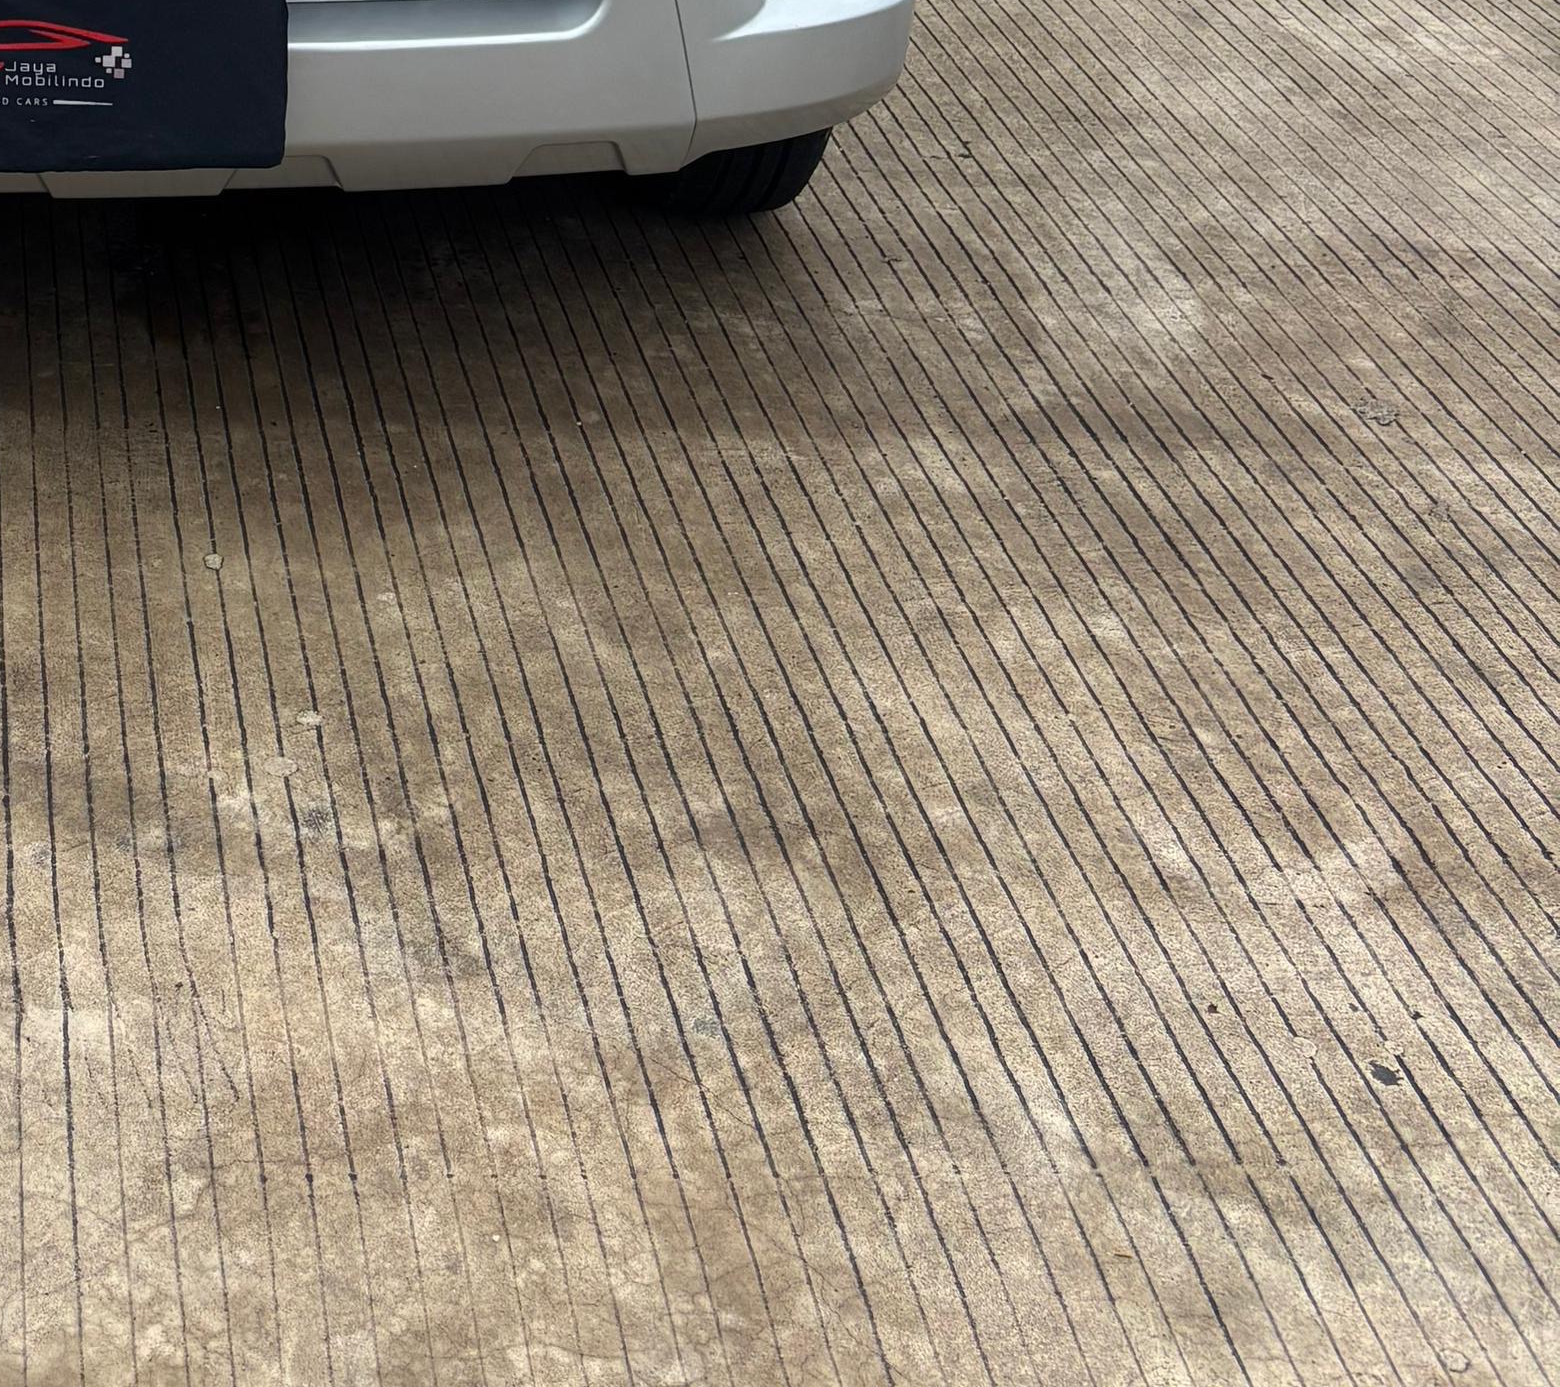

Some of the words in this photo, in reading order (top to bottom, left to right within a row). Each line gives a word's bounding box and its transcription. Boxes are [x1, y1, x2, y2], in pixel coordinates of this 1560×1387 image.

[5, 60, 56, 76] Jaya
[5, 74, 105, 88] Mobilindo
[16, 96, 49, 107] CARS
